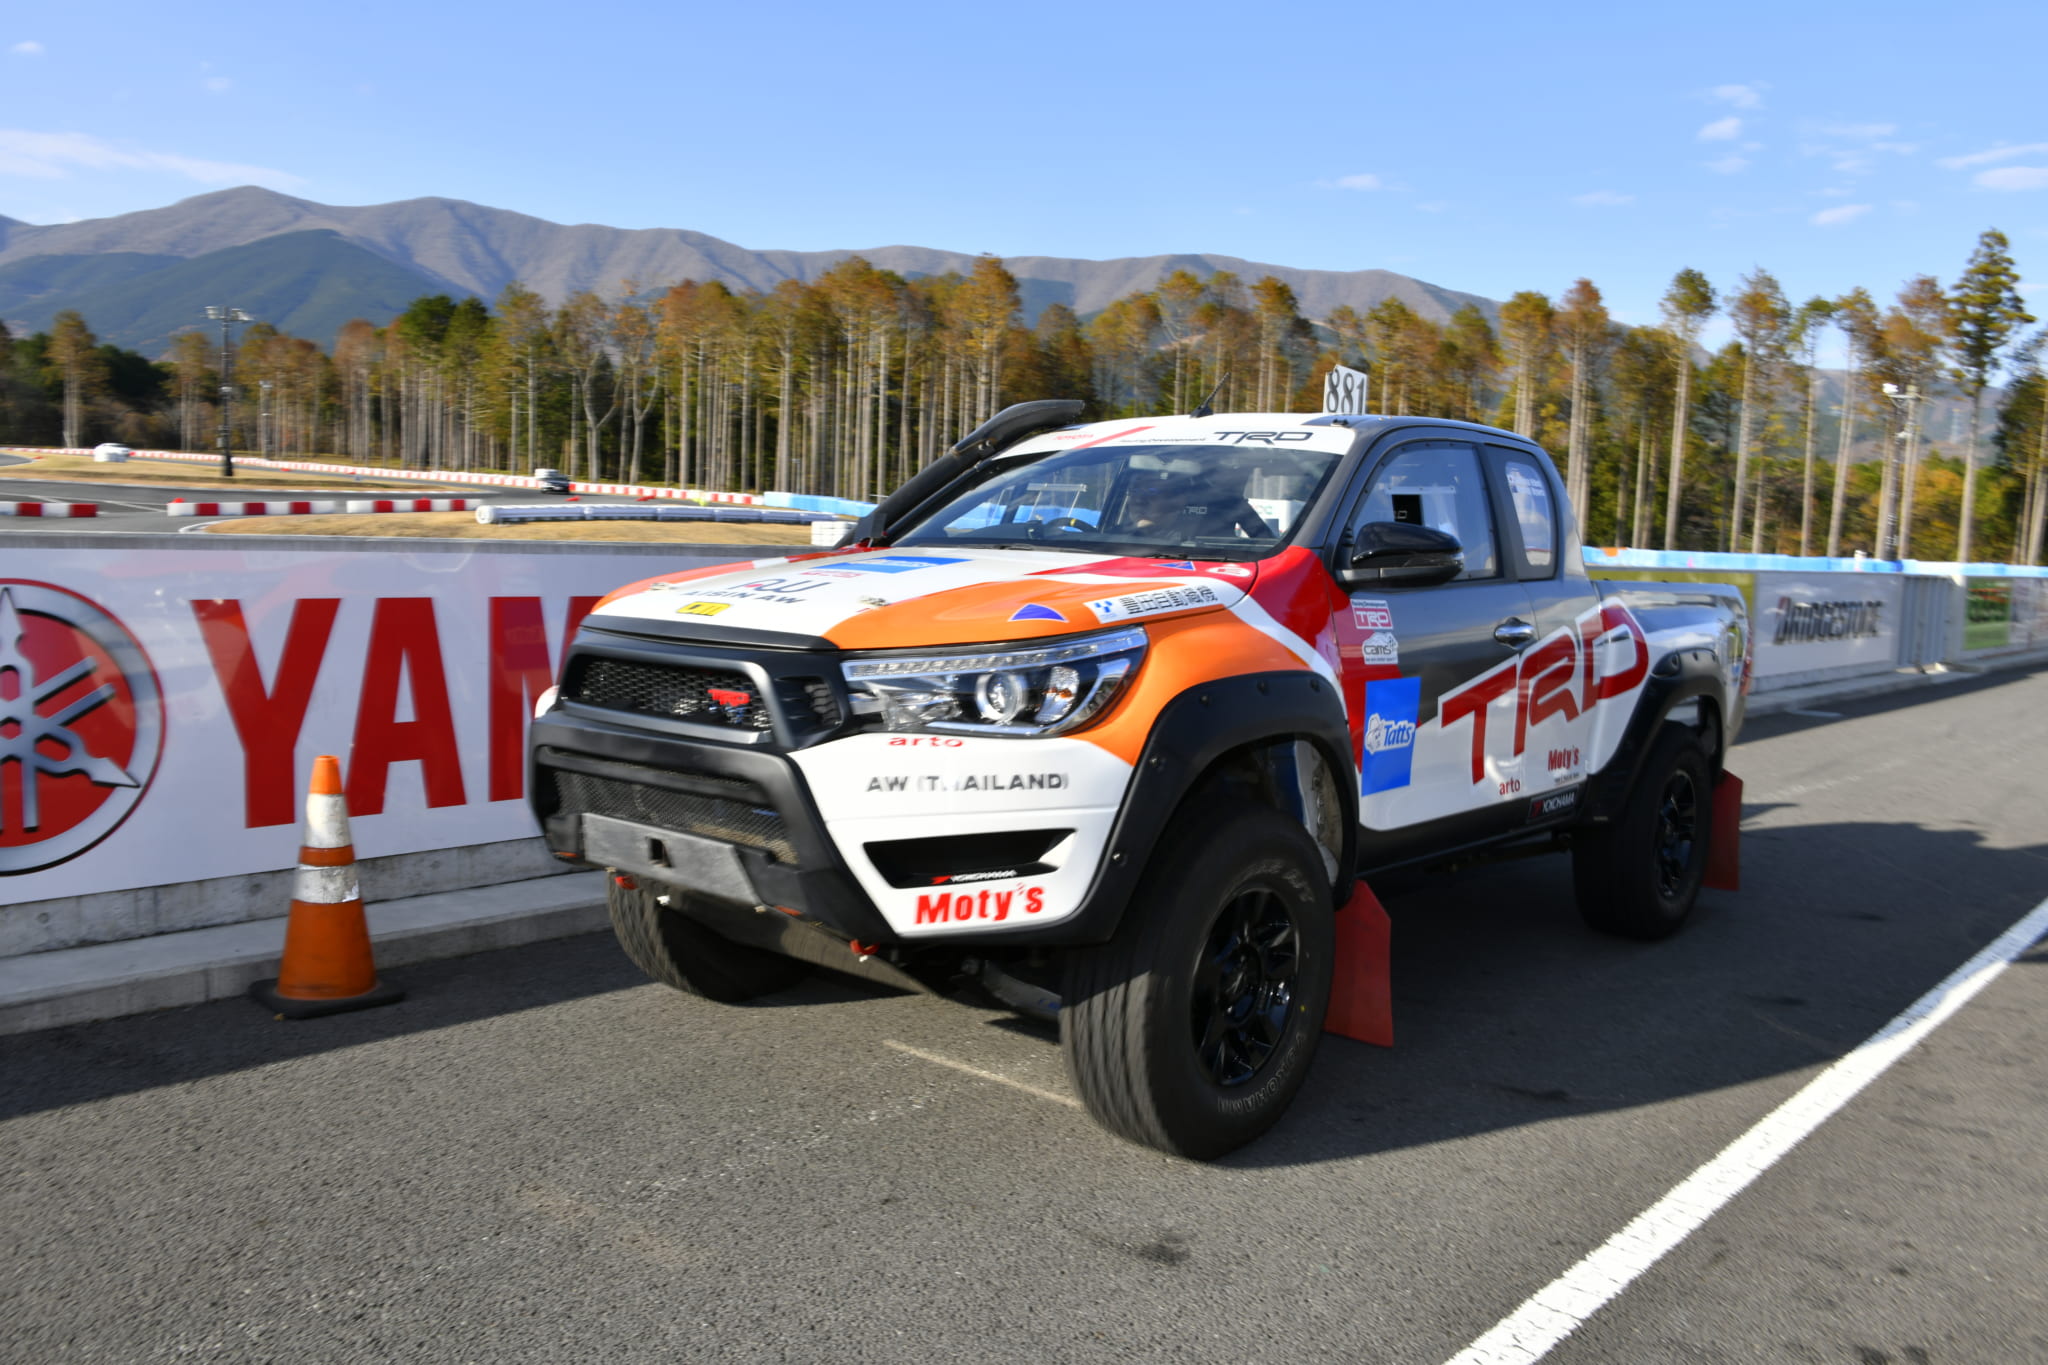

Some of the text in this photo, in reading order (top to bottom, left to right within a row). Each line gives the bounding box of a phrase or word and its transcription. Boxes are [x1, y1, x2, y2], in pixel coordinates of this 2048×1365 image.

[1326, 368, 1366, 416] 881
[1213, 431, 1314, 446] TRD
[756, 594, 806, 604] AW
[1355, 611, 1389, 627] TRD
[1441, 603, 1649, 786] TRD
[888, 736, 964, 748] arto
[1384, 724, 1412, 746] Tatts
[1547, 744, 1580, 772] Moty's
[866, 773, 1070, 792] AW (TAILAND)
[1499, 778, 1521, 796] arto
[914, 882, 1045, 925] Moty's
